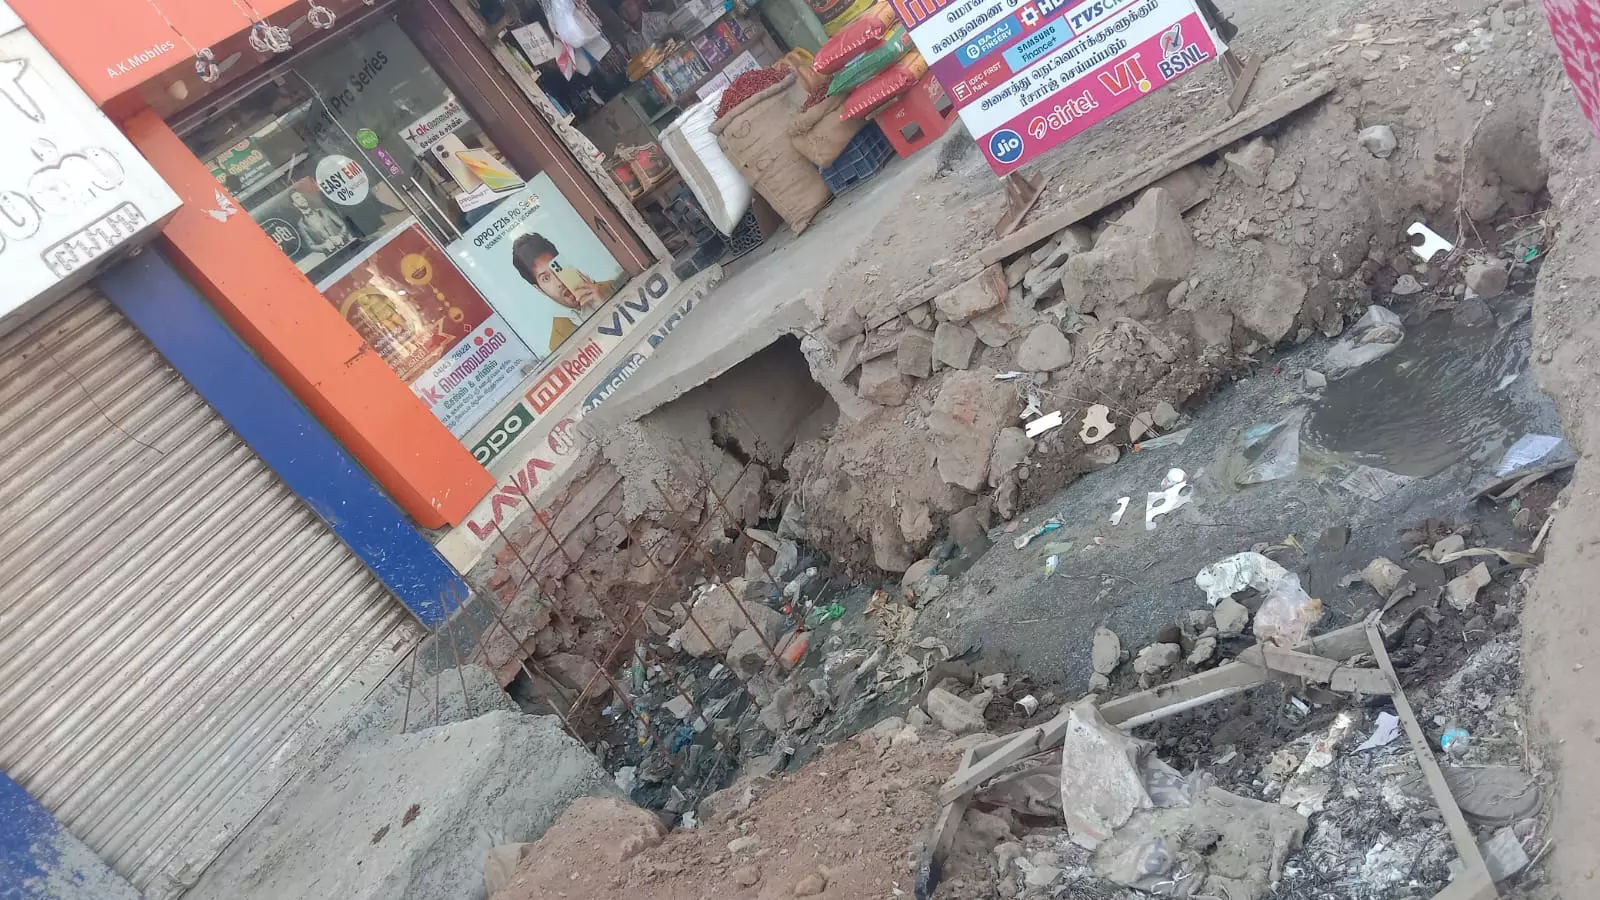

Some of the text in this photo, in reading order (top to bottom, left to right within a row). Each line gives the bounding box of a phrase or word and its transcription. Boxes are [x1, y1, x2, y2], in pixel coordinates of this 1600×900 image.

[978, 23, 1010, 46] BAJAJ
[981, 29, 1013, 52] FINSERV
[1017, 26, 1056, 54] SAMSUNG
[1021, 36, 1057, 63] Finance+
[983, 61, 1002, 77] FIRST
[1157, 42, 1210, 81] BSNL
[329, 88, 355, 115] Pro
[350, 50, 388, 92] Series
[981, 77, 1032, 111] அனைத்து
[1047, 90, 1100, 131] airtel
[996, 137, 1020, 157] Jio
[319, 171, 347, 195] EASY
[341, 160, 363, 180] EMI
[337, 186, 355, 202] 0%
[473, 227, 495, 247] OPPO
[492, 215, 511, 232] F21s
[507, 207, 521, 220] Pro
[473, 414, 523, 465] ppo
[561, 337, 604, 381] Redmi
[466, 458, 556, 541] LAVA
